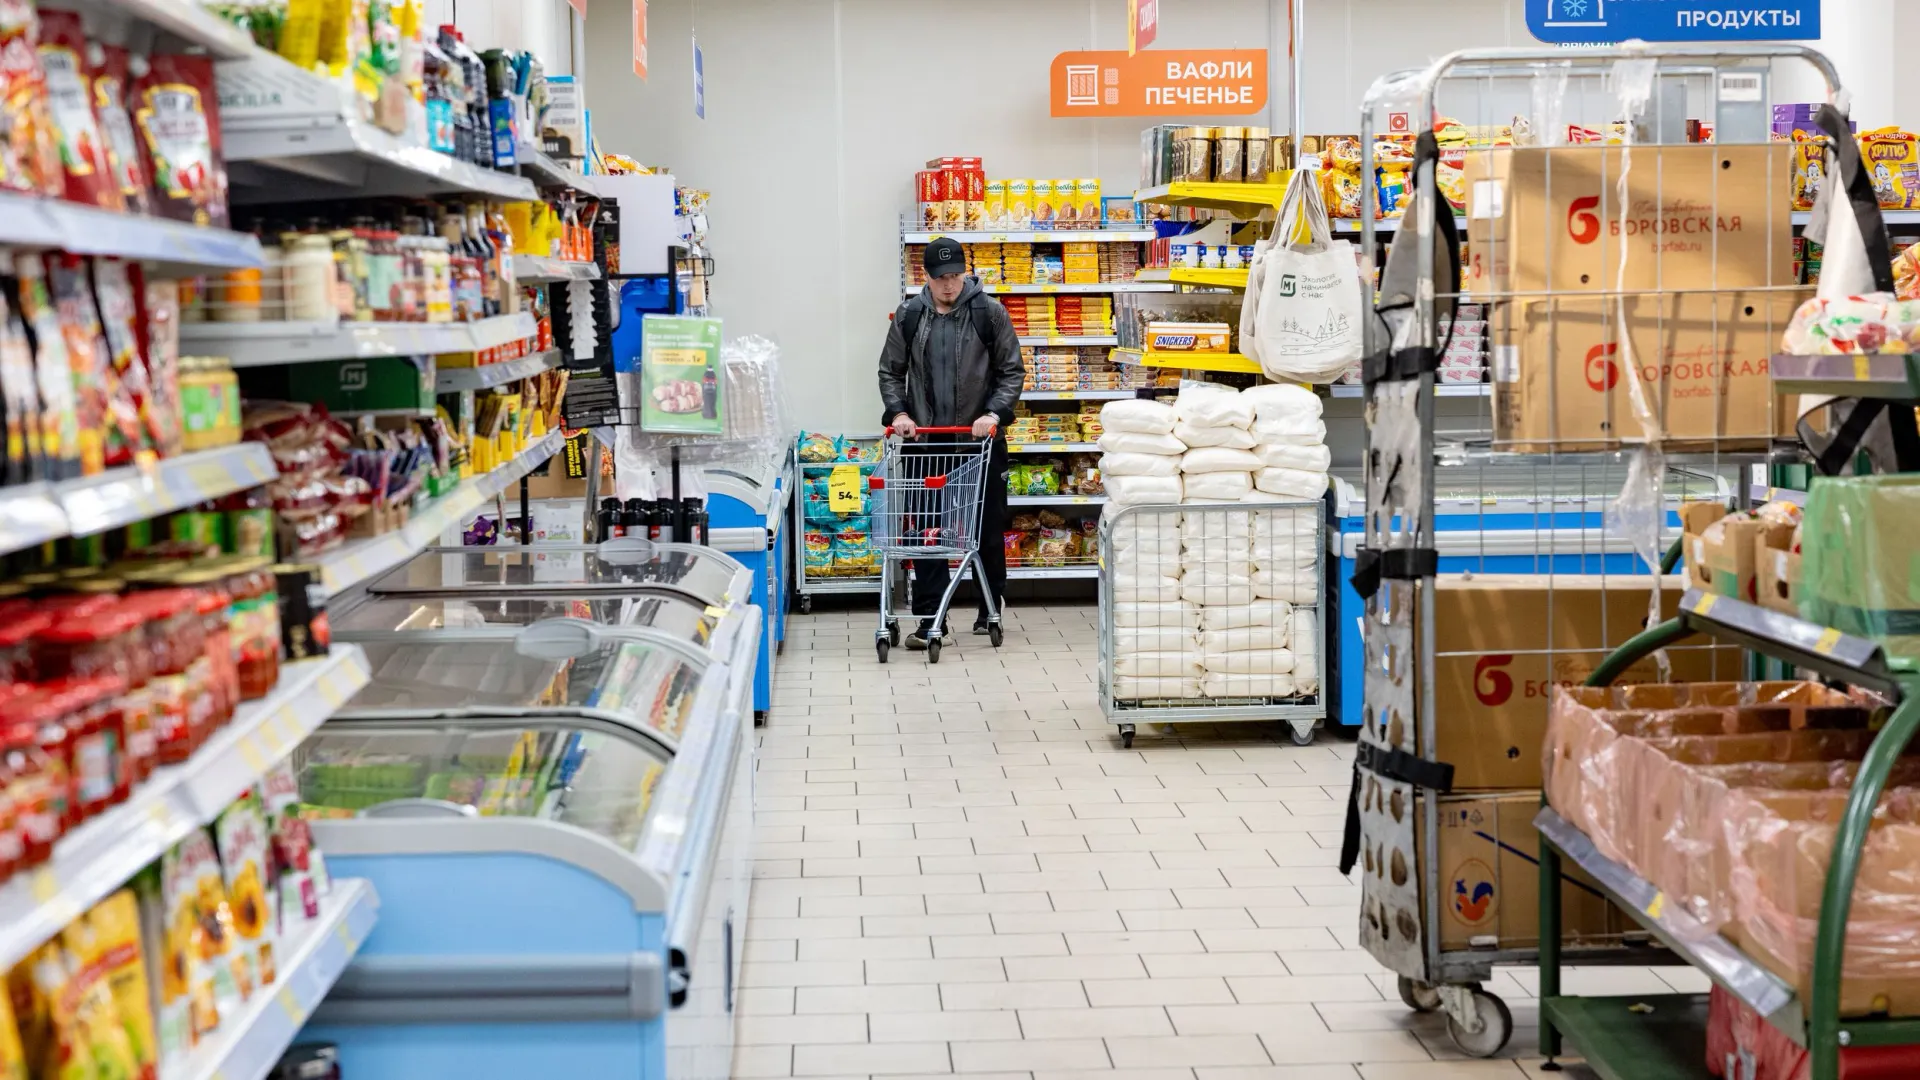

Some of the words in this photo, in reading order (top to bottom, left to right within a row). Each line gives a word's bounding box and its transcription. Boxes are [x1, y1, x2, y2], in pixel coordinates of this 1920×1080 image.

[1676, 10, 1800, 29] ПРОДУКТЫ
[1166, 61, 1252, 80] ВАФЛИ
[1145, 86, 1253, 104] ПЕЧЕНЬЕ
[1870, 132, 1908, 140] ВЫГОДНО
[1871, 144, 1907, 158] ХРУТКА
[1610, 216, 1742, 236] БОРОВСКАЯ
[1156, 335, 1194, 346] SNICKERS
[838, 491, 853, 500] 54
